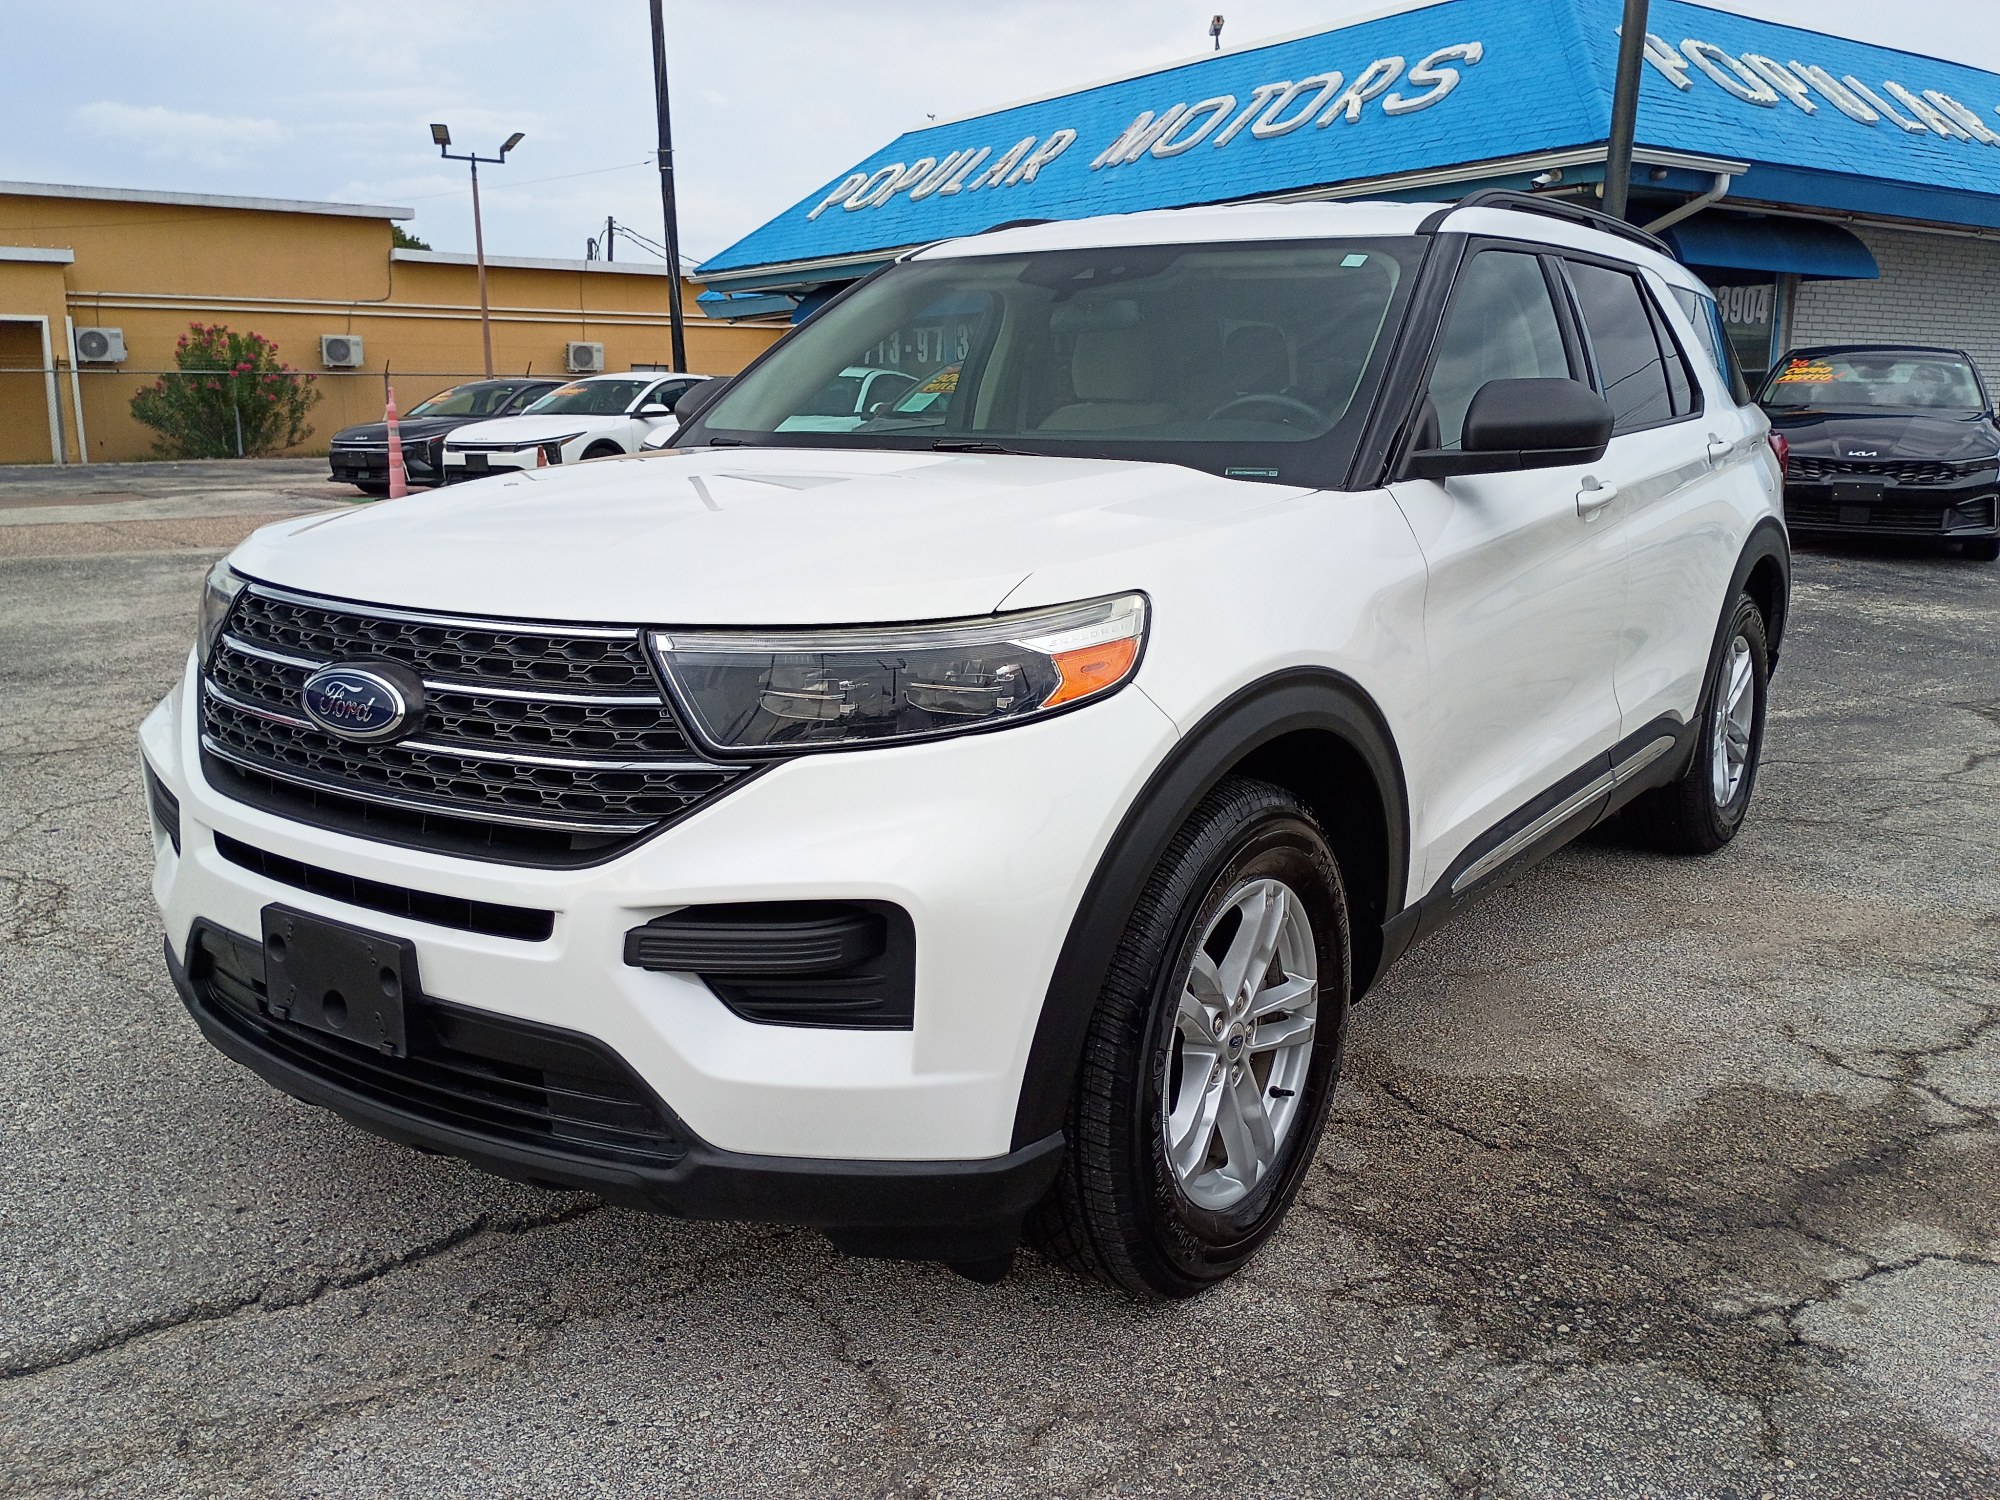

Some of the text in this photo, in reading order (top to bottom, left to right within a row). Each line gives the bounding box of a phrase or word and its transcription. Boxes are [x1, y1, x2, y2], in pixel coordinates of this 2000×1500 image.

[806, 41, 1483, 221] POPULAR MOTORS
[320, 681, 376, 722] Ford
